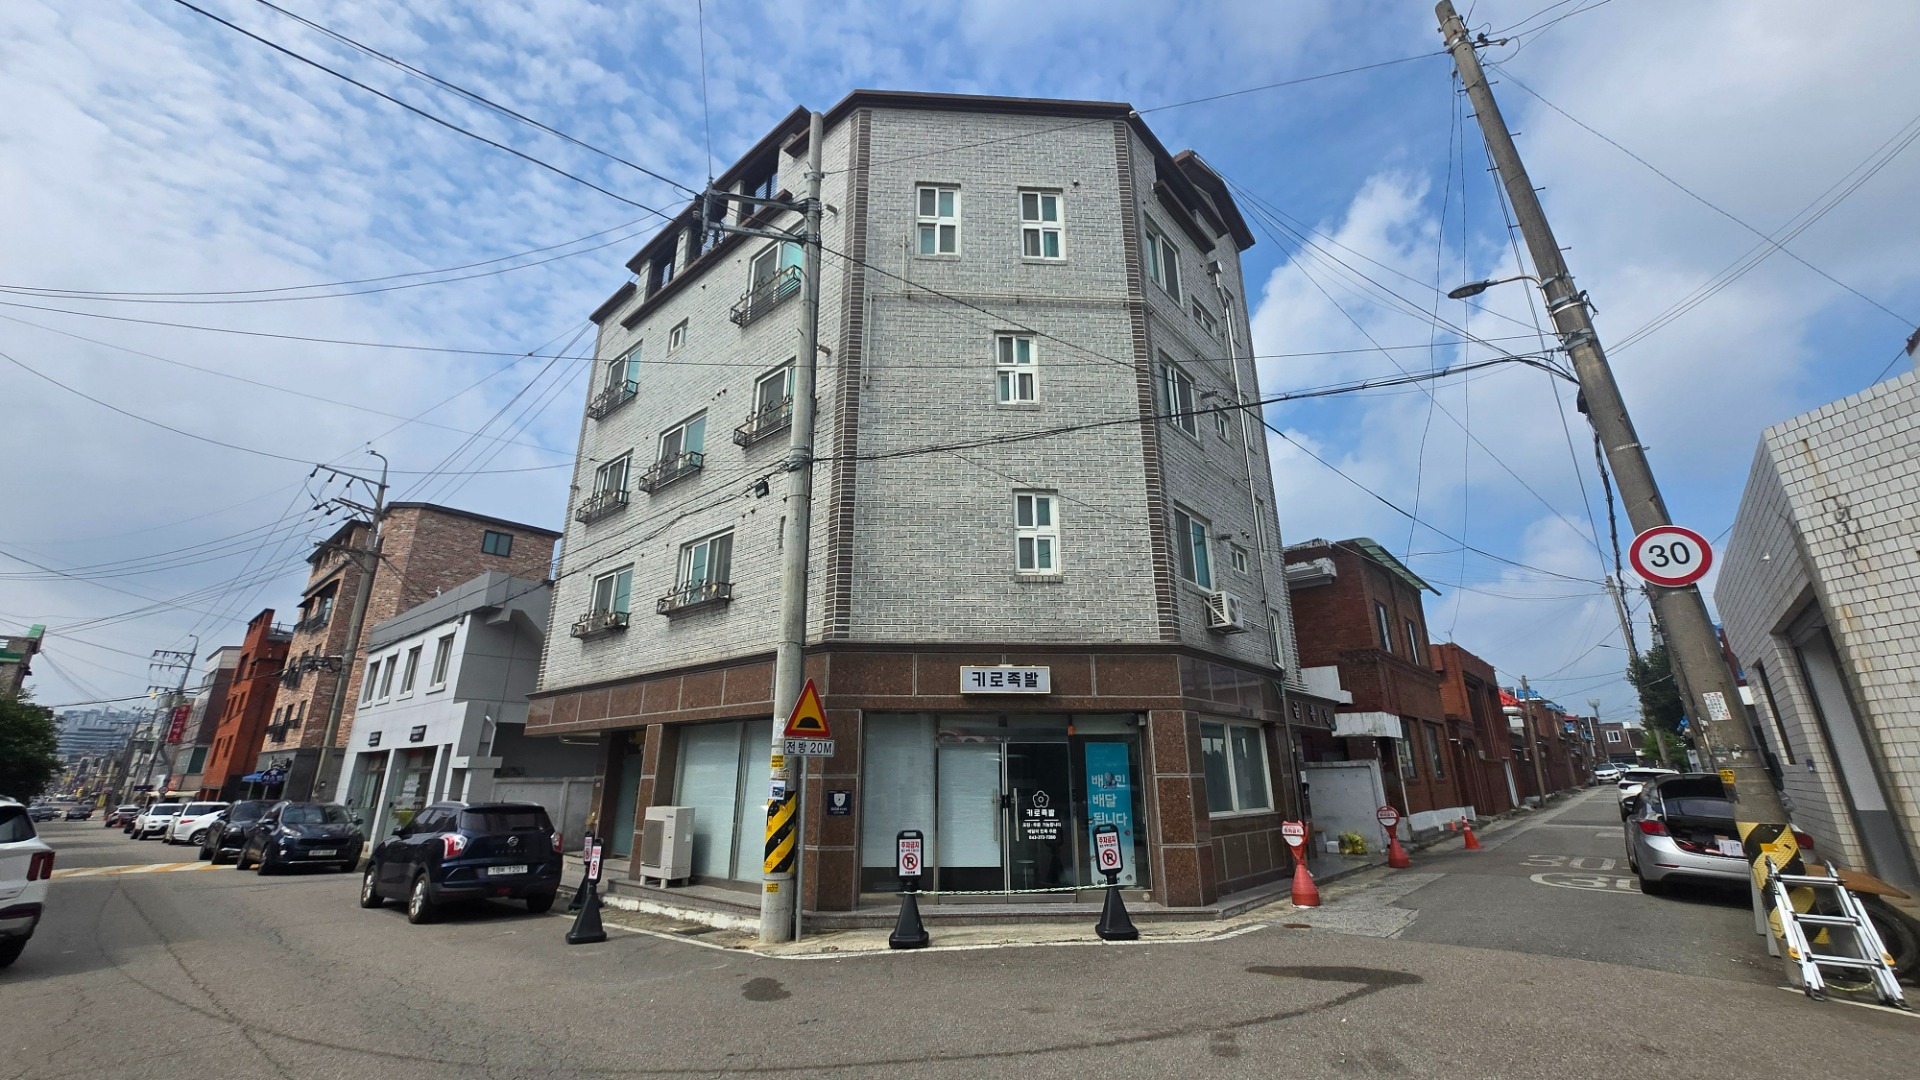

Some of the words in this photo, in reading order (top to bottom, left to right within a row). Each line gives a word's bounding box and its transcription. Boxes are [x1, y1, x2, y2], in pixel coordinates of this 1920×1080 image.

[1648, 541, 1690, 568] 30
[972, 671, 1038, 688] 키로족발
[787, 741, 807, 754] 전방
[809, 742, 832, 754] 20M
[1092, 793, 1117, 808] 배달
[1026, 808, 1055, 817] 키로족발
[1093, 811, 1128, 827] 됩니다
[901, 841, 920, 849] 주차금지
[1098, 836, 1116, 844] 주차금지
